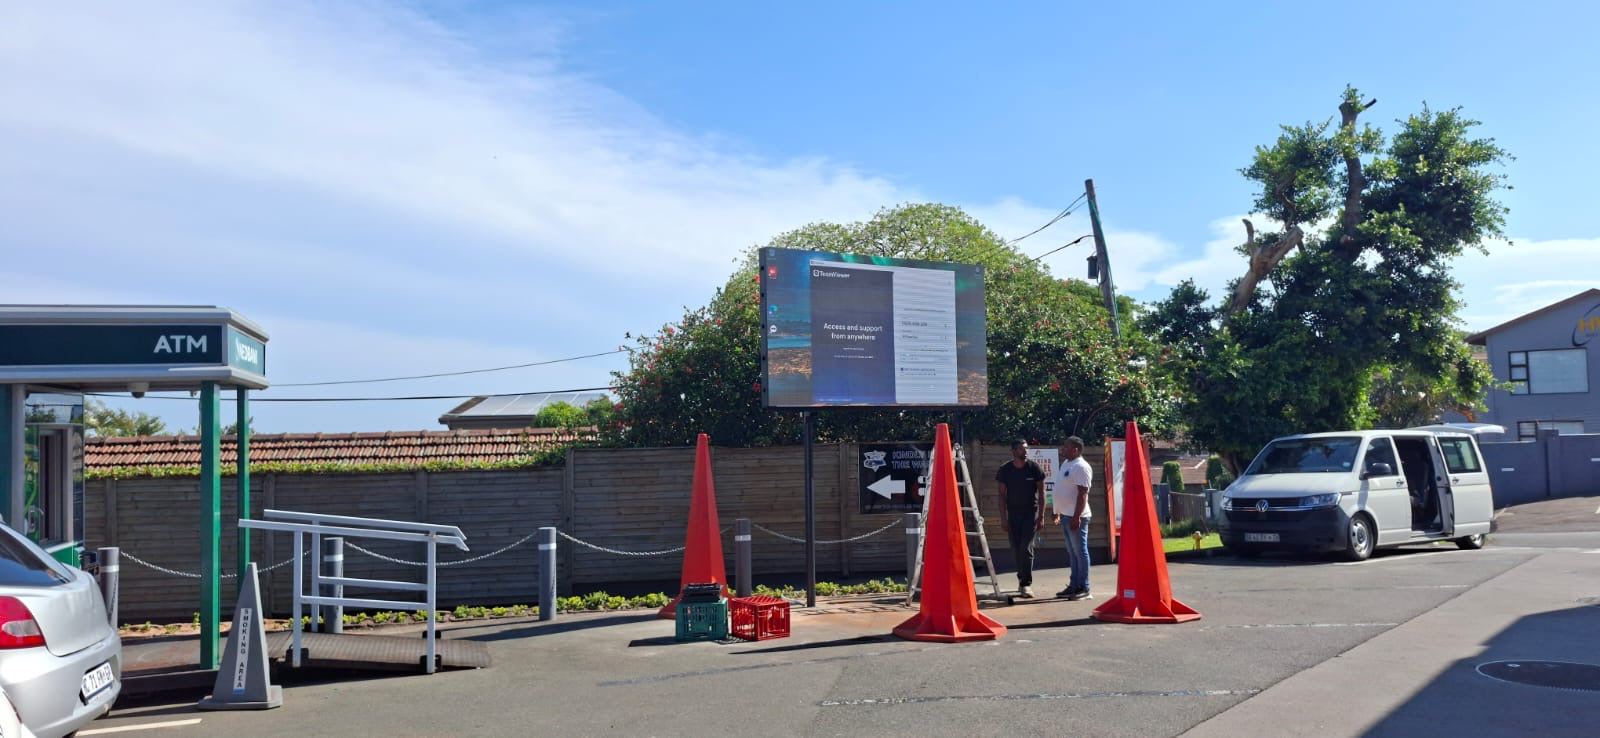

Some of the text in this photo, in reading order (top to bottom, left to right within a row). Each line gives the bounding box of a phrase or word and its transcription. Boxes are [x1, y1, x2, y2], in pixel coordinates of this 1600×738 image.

[819, 270, 851, 279] TeamViewer
[823, 322, 846, 331] Access
[859, 325, 883, 333] support
[831, 332, 876, 342] from anywhere
[153, 335, 208, 353] ATM
[237, 609, 249, 687] SMOKING AREA
